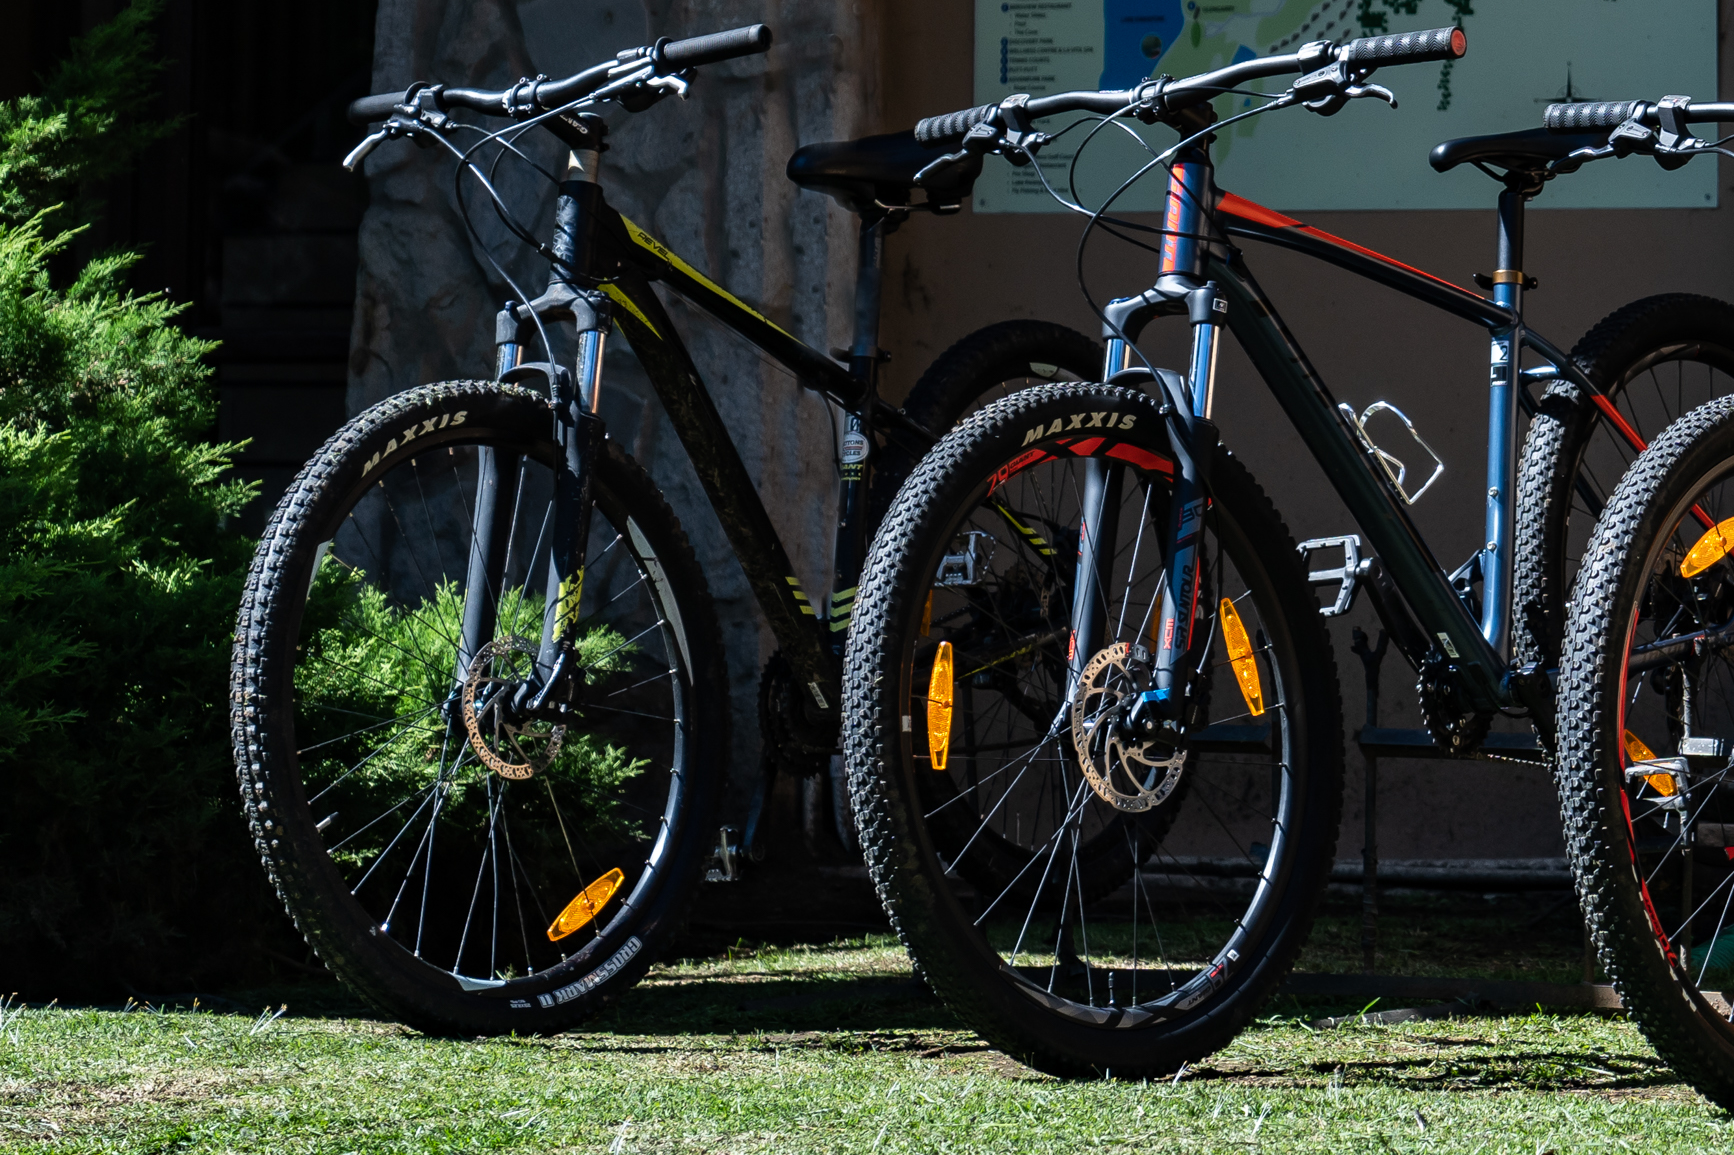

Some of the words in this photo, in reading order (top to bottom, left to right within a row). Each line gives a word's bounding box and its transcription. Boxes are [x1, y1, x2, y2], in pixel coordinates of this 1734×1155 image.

[637, 231, 671, 263] REVEL
[361, 410, 469, 479] MAXXIS
[1021, 411, 1137, 448] MAXXIS
[1178, 565, 1194, 624] SUNTOUR
[1163, 617, 1174, 650] XCM
[553, 935, 643, 1005] CROSSMARK
